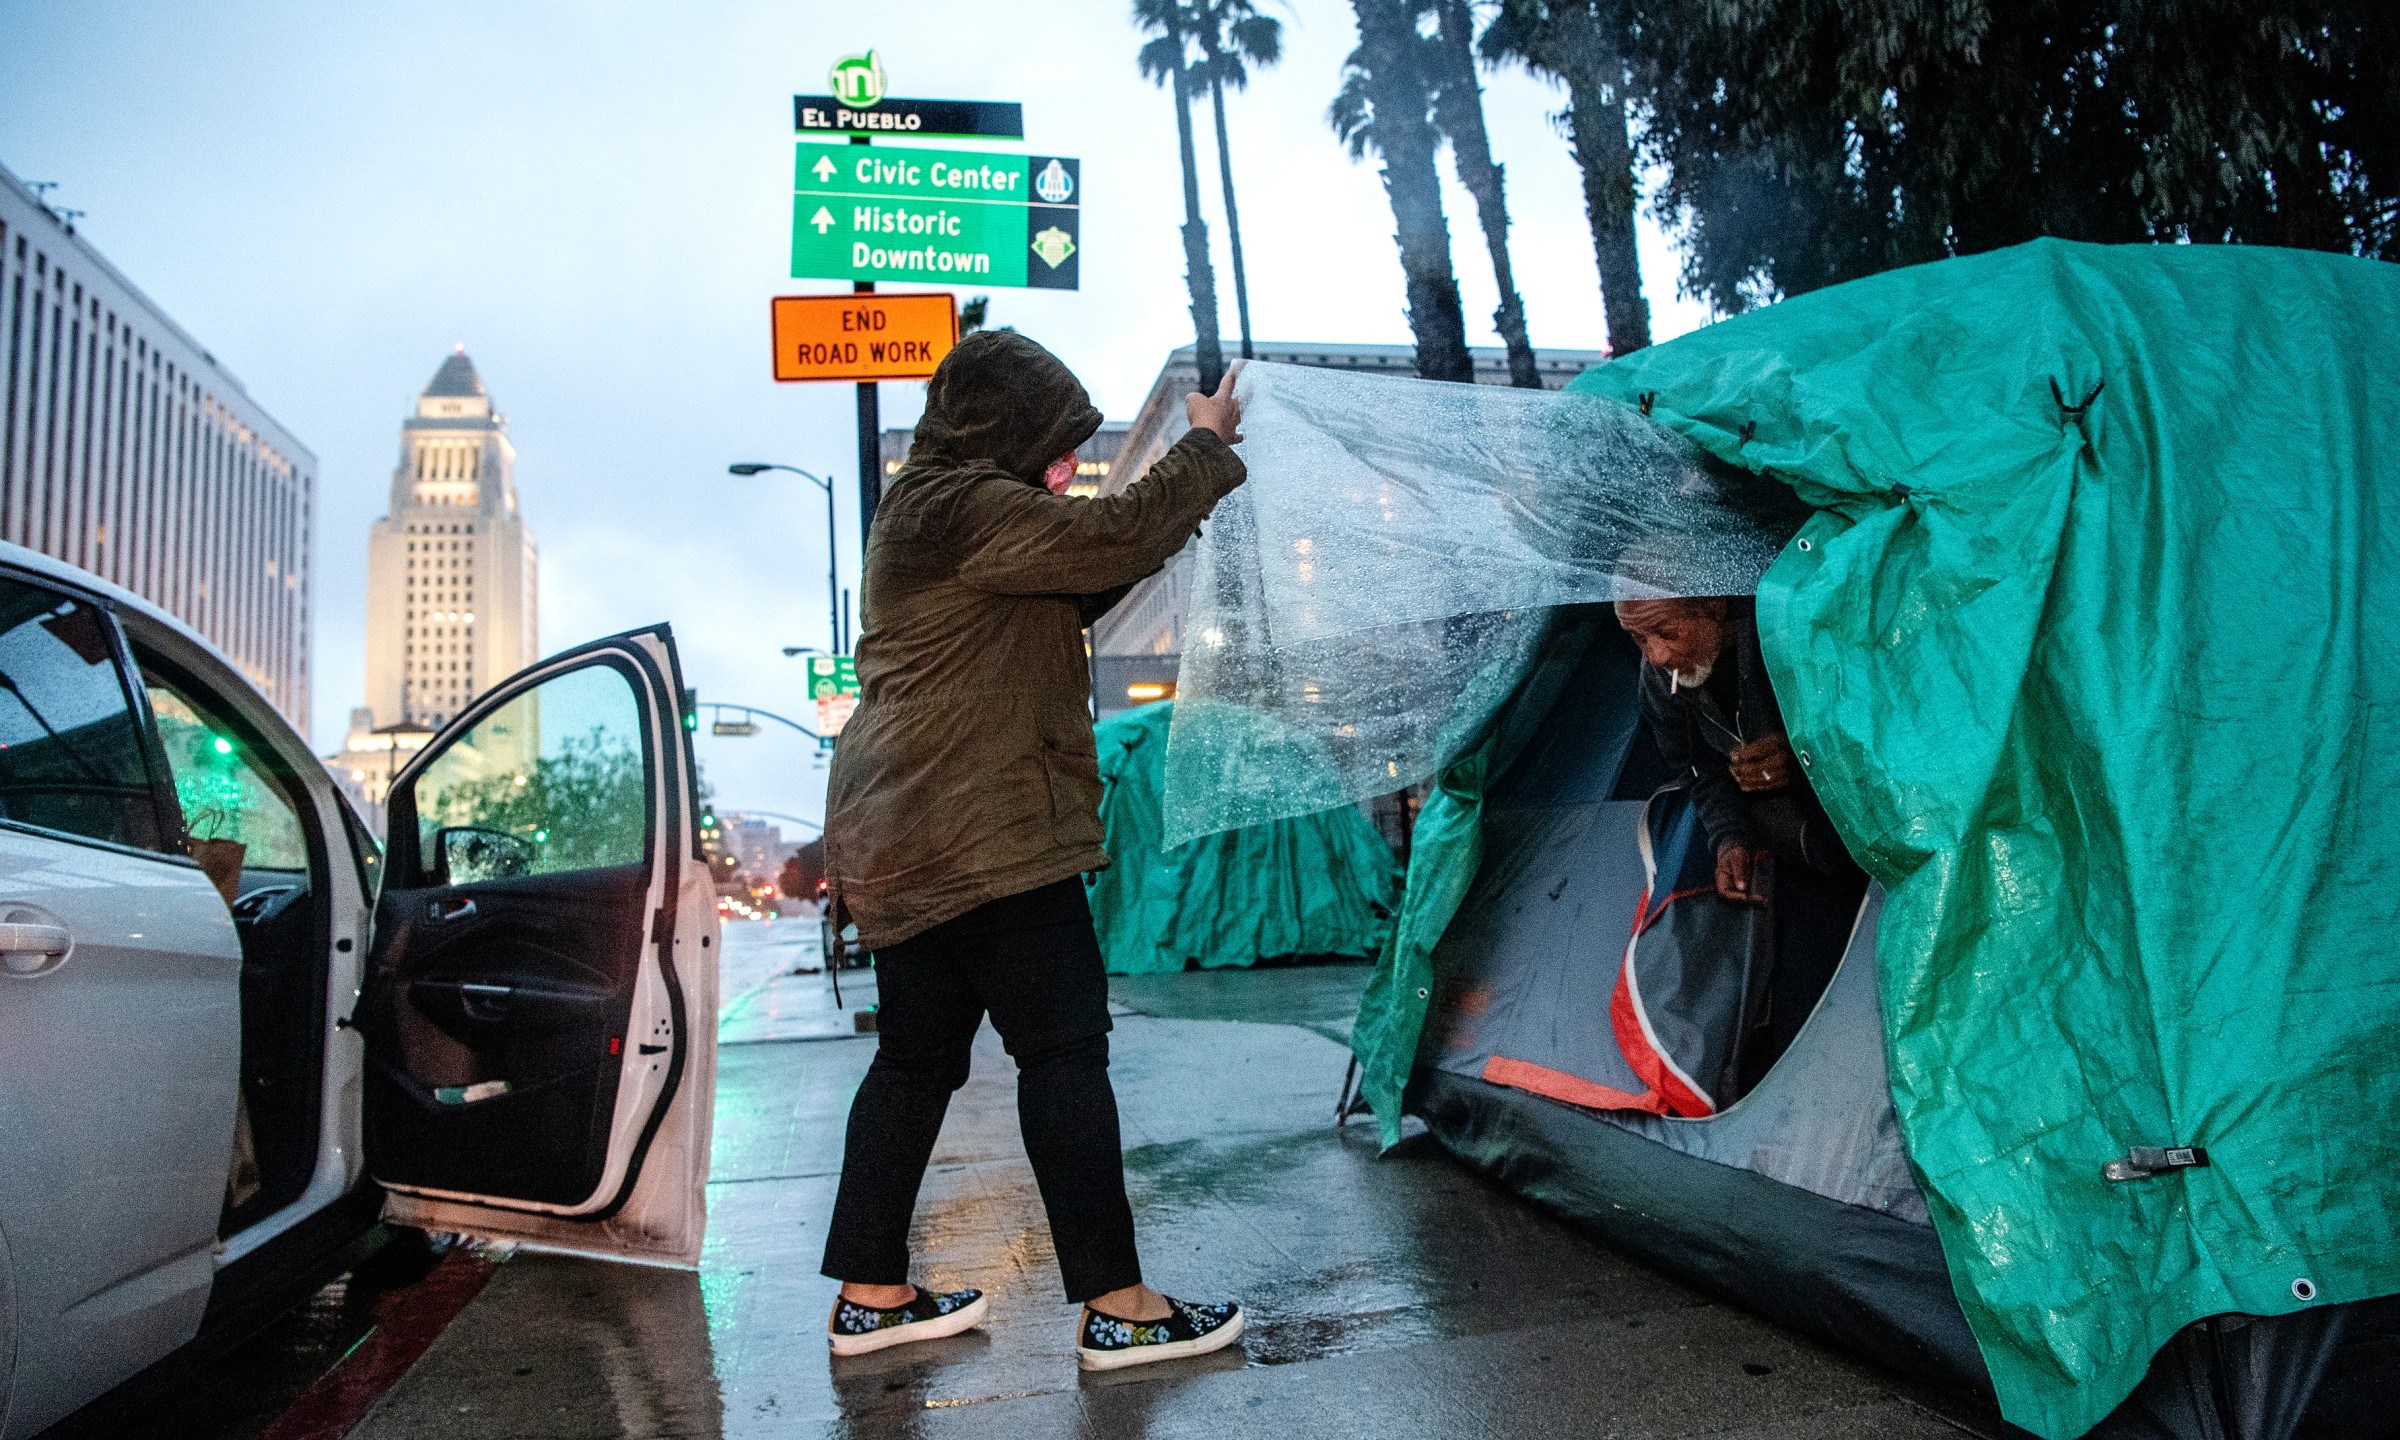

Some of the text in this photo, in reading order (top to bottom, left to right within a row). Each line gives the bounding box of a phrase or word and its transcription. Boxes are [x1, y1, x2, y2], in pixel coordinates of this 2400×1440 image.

[803, 108, 921, 130] EL PUEBLO
[856, 158, 1020, 191] Civic Center
[854, 206, 961, 236] Historic
[853, 242, 990, 273] Downtown
[842, 310, 886, 331] END
[798, 341, 931, 365] ROAD WORK
